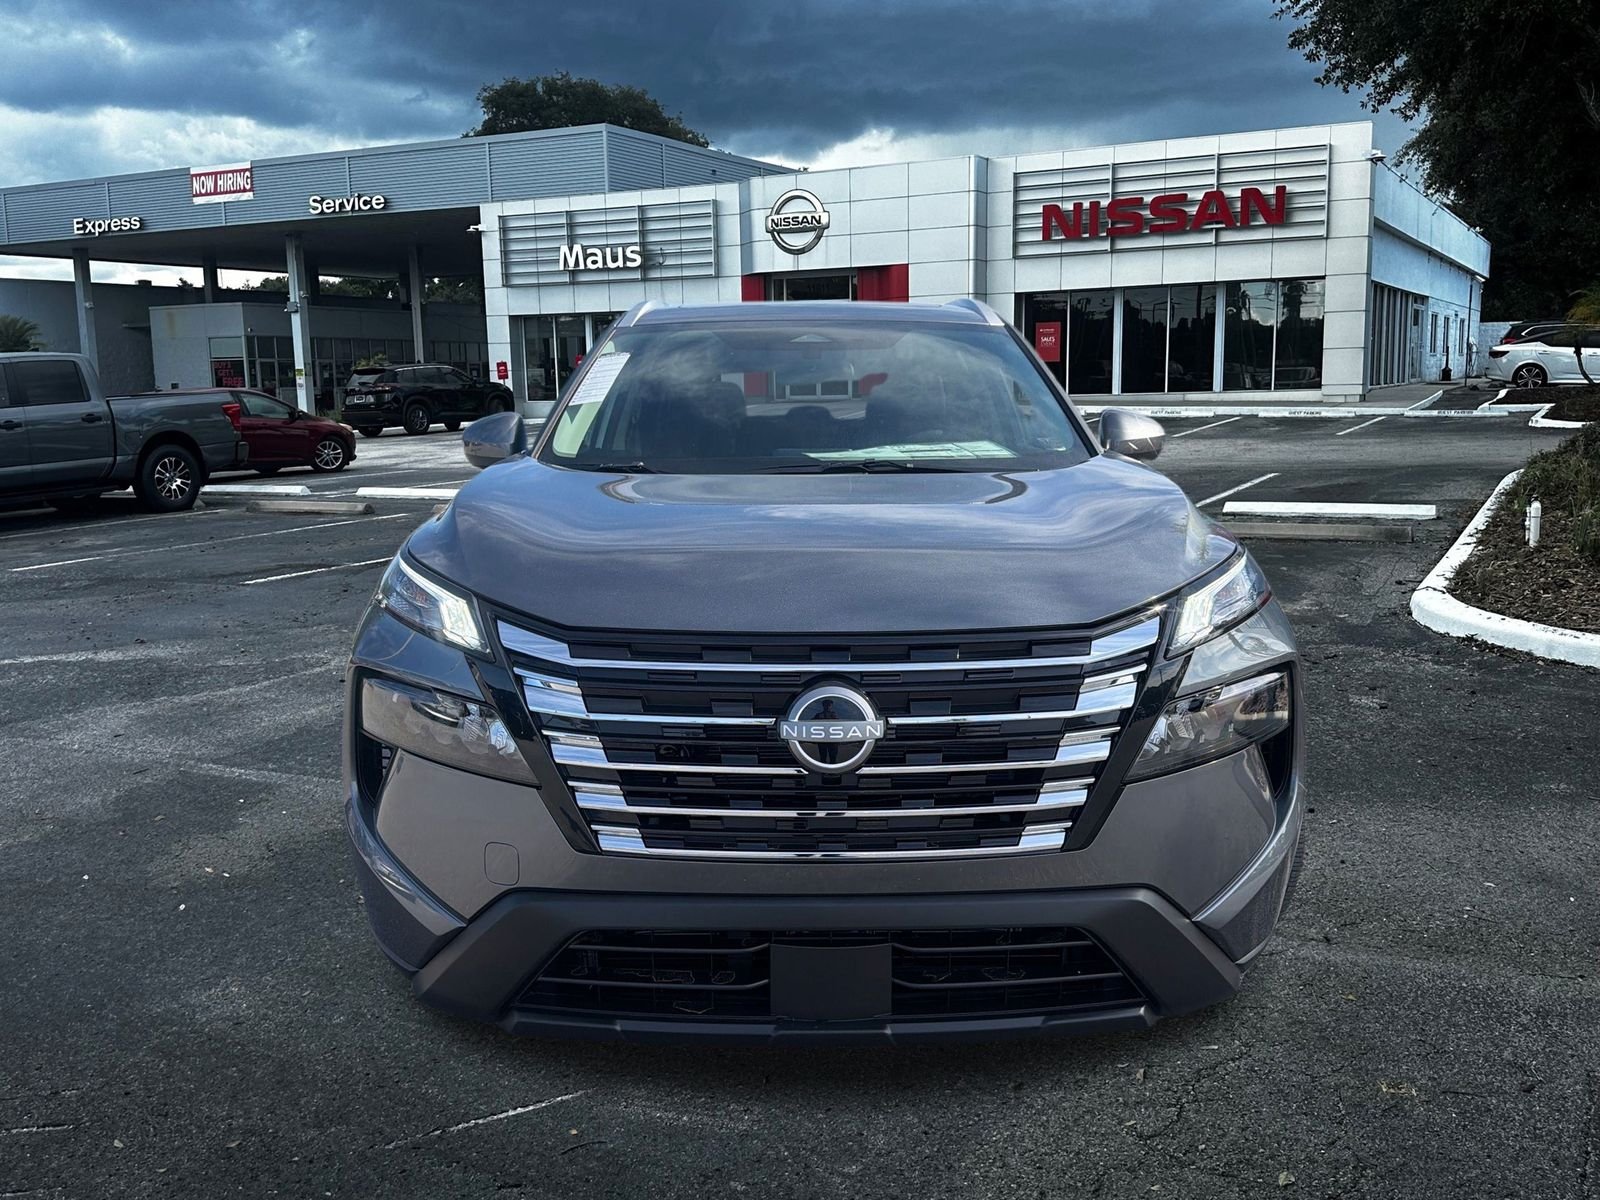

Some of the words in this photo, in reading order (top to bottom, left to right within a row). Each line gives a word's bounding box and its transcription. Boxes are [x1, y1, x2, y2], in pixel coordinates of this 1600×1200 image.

[192, 175, 215, 195] NOW
[217, 171, 251, 192] HIRING
[308, 193, 386, 214] Service
[1042, 185, 1287, 241] NISSAN
[73, 216, 141, 237] Express
[770, 215, 822, 229] NISSAN
[559, 243, 642, 271] Maus
[222, 377, 244, 387] FREE
[783, 724, 881, 738] NISSAN
